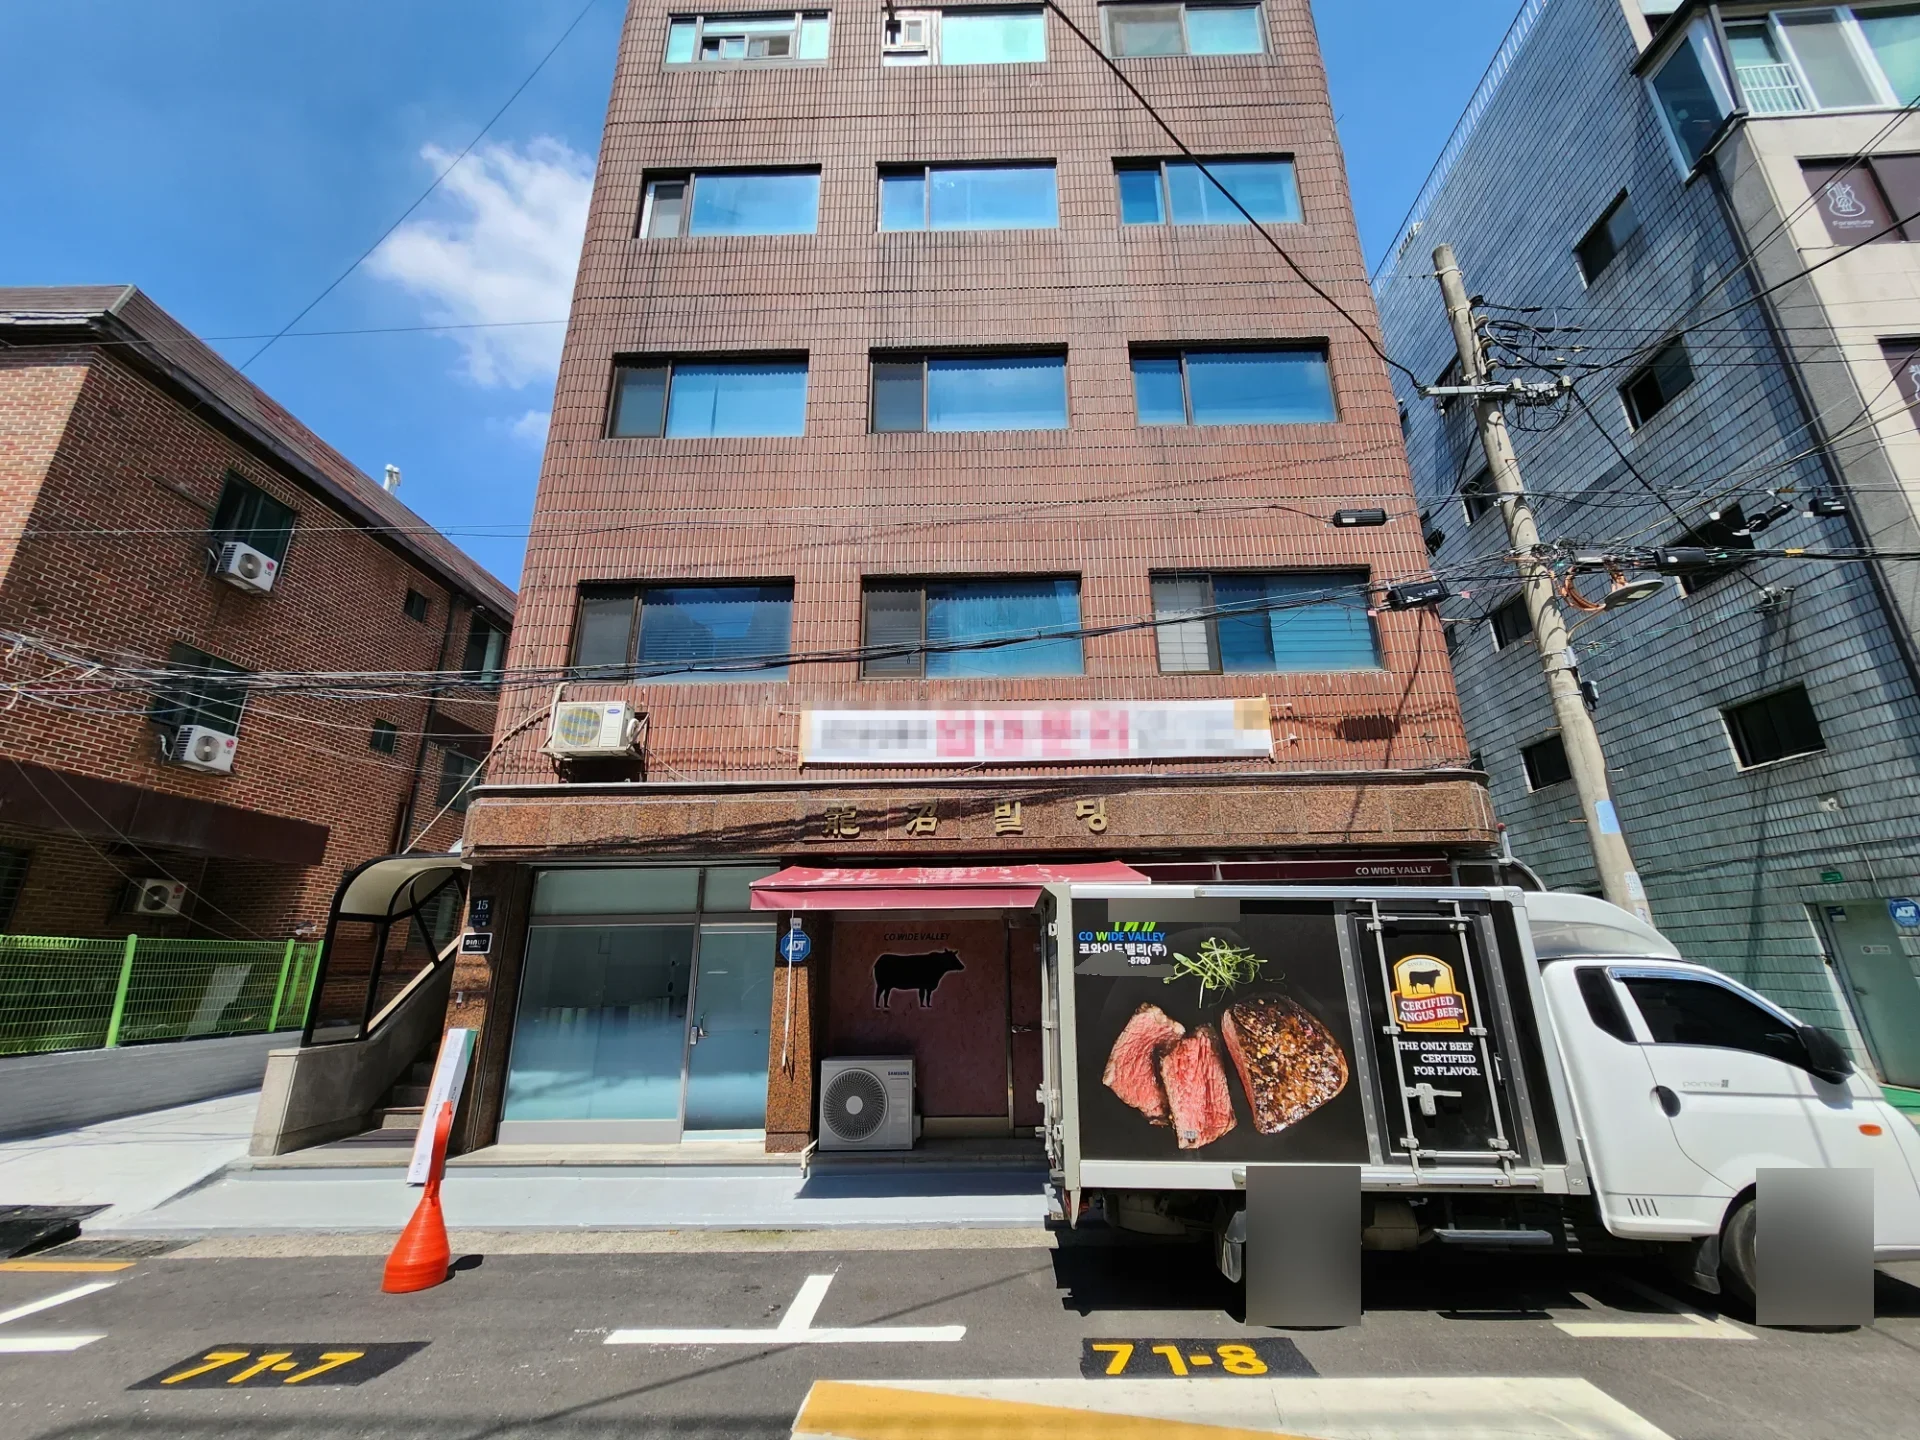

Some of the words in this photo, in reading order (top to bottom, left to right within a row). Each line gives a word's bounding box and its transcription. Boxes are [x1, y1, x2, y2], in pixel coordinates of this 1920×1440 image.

[1355, 867, 1369, 875] CO
[1370, 866, 1396, 875] WIDE
[1396, 865, 1433, 874] VALLEY
[476, 899, 489, 910] 15
[1895, 905, 1916, 917] ADT
[884, 933, 896, 941] CO
[897, 932, 919, 941] WIDE
[920, 932, 951, 941] VALLEY
[1078, 931, 1093, 941] CO
[1095, 931, 1125, 941] WIDE
[1127, 931, 1166, 941] VALLEY
[785, 940, 807, 952] ADT
[1400, 996, 1455, 1011] CERTIFIED
[1399, 1010, 1435, 1022] ANGUS
[1398, 1041, 1420, 1051] THE
[1420, 1042, 1448, 1051] ONLY
[1448, 1041, 1474, 1051] BEEF
[1420, 1054, 1477, 1064] CERTIFIED
[1413, 1066, 1436, 1076] FOR
[1437, 1066, 1482, 1076] FLAVOR.
[1091, 1344, 1269, 1376] 71-8
[160, 1351, 365, 1385] 71-7
